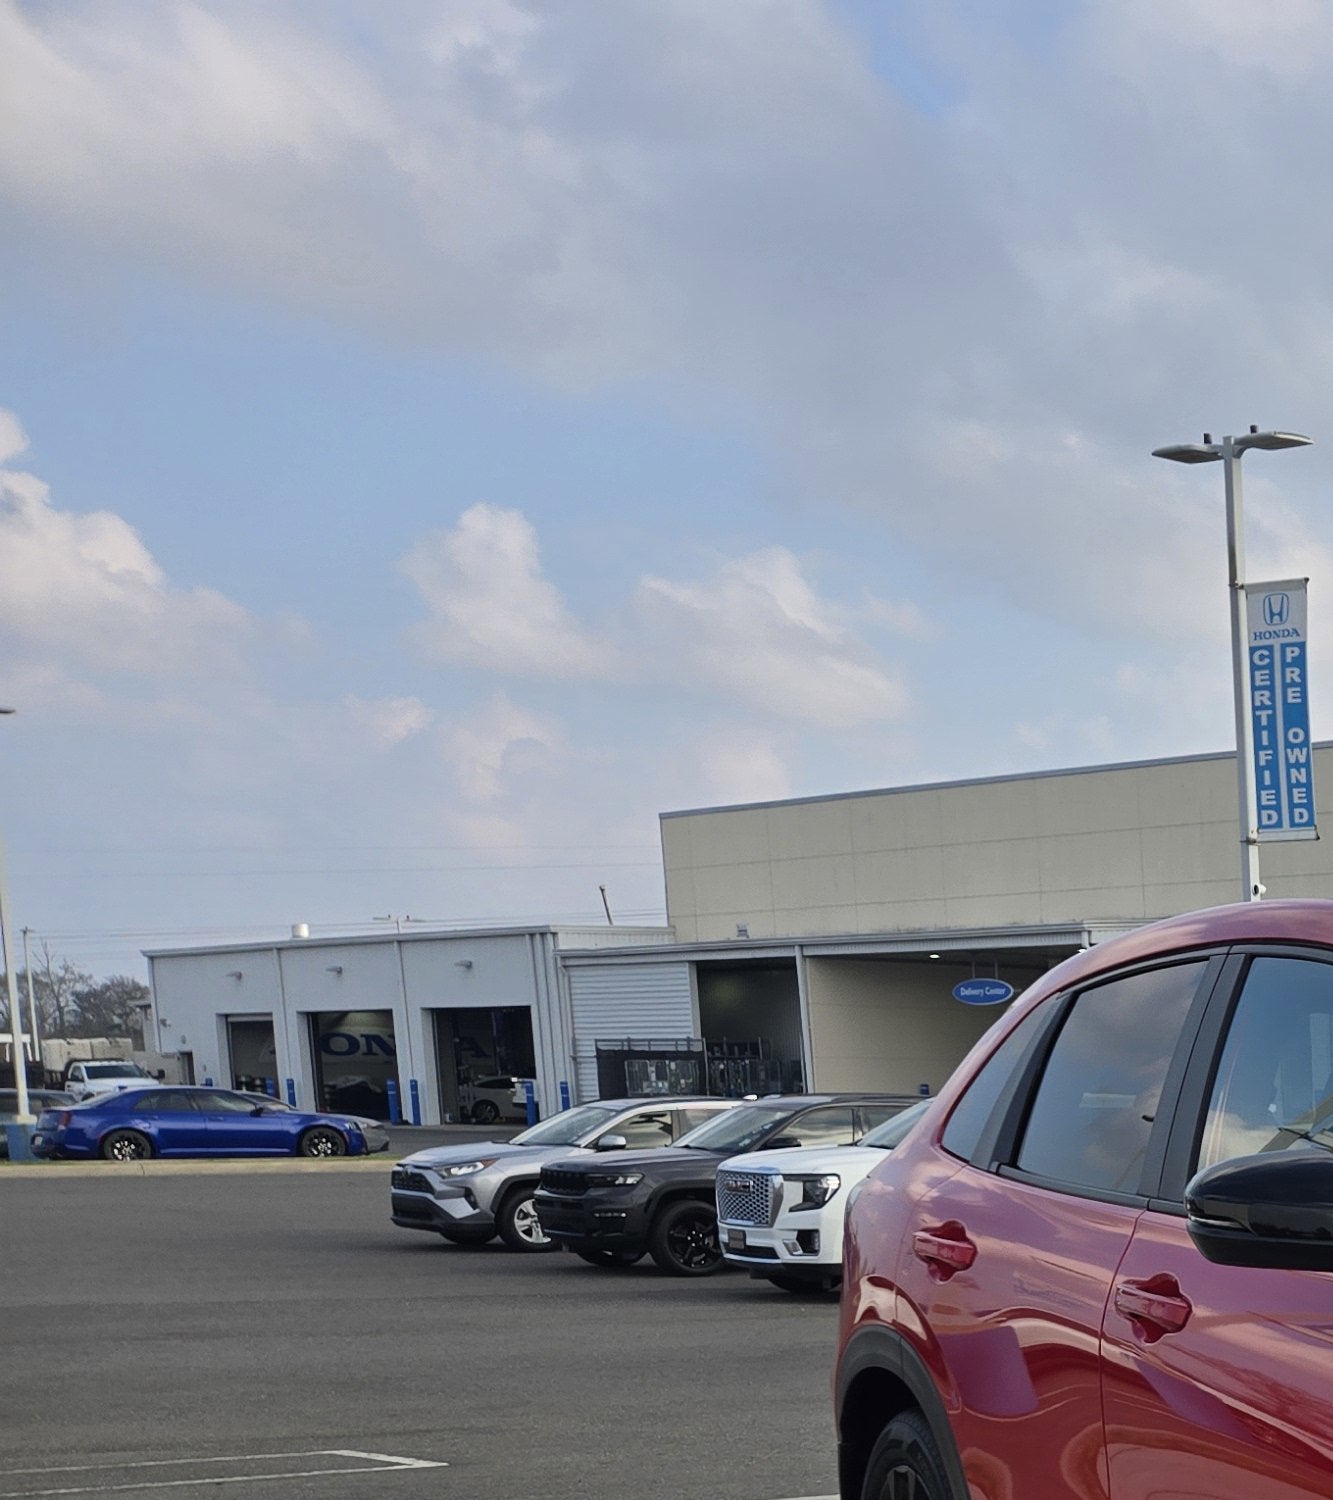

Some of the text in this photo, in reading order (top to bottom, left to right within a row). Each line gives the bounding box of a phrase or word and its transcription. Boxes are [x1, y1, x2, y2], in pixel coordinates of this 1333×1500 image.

[1253, 627, 1300, 641] HONDA
[1252, 649, 1278, 826] CERTIFIED
[1285, 646, 1309, 824] PRE OWNED
